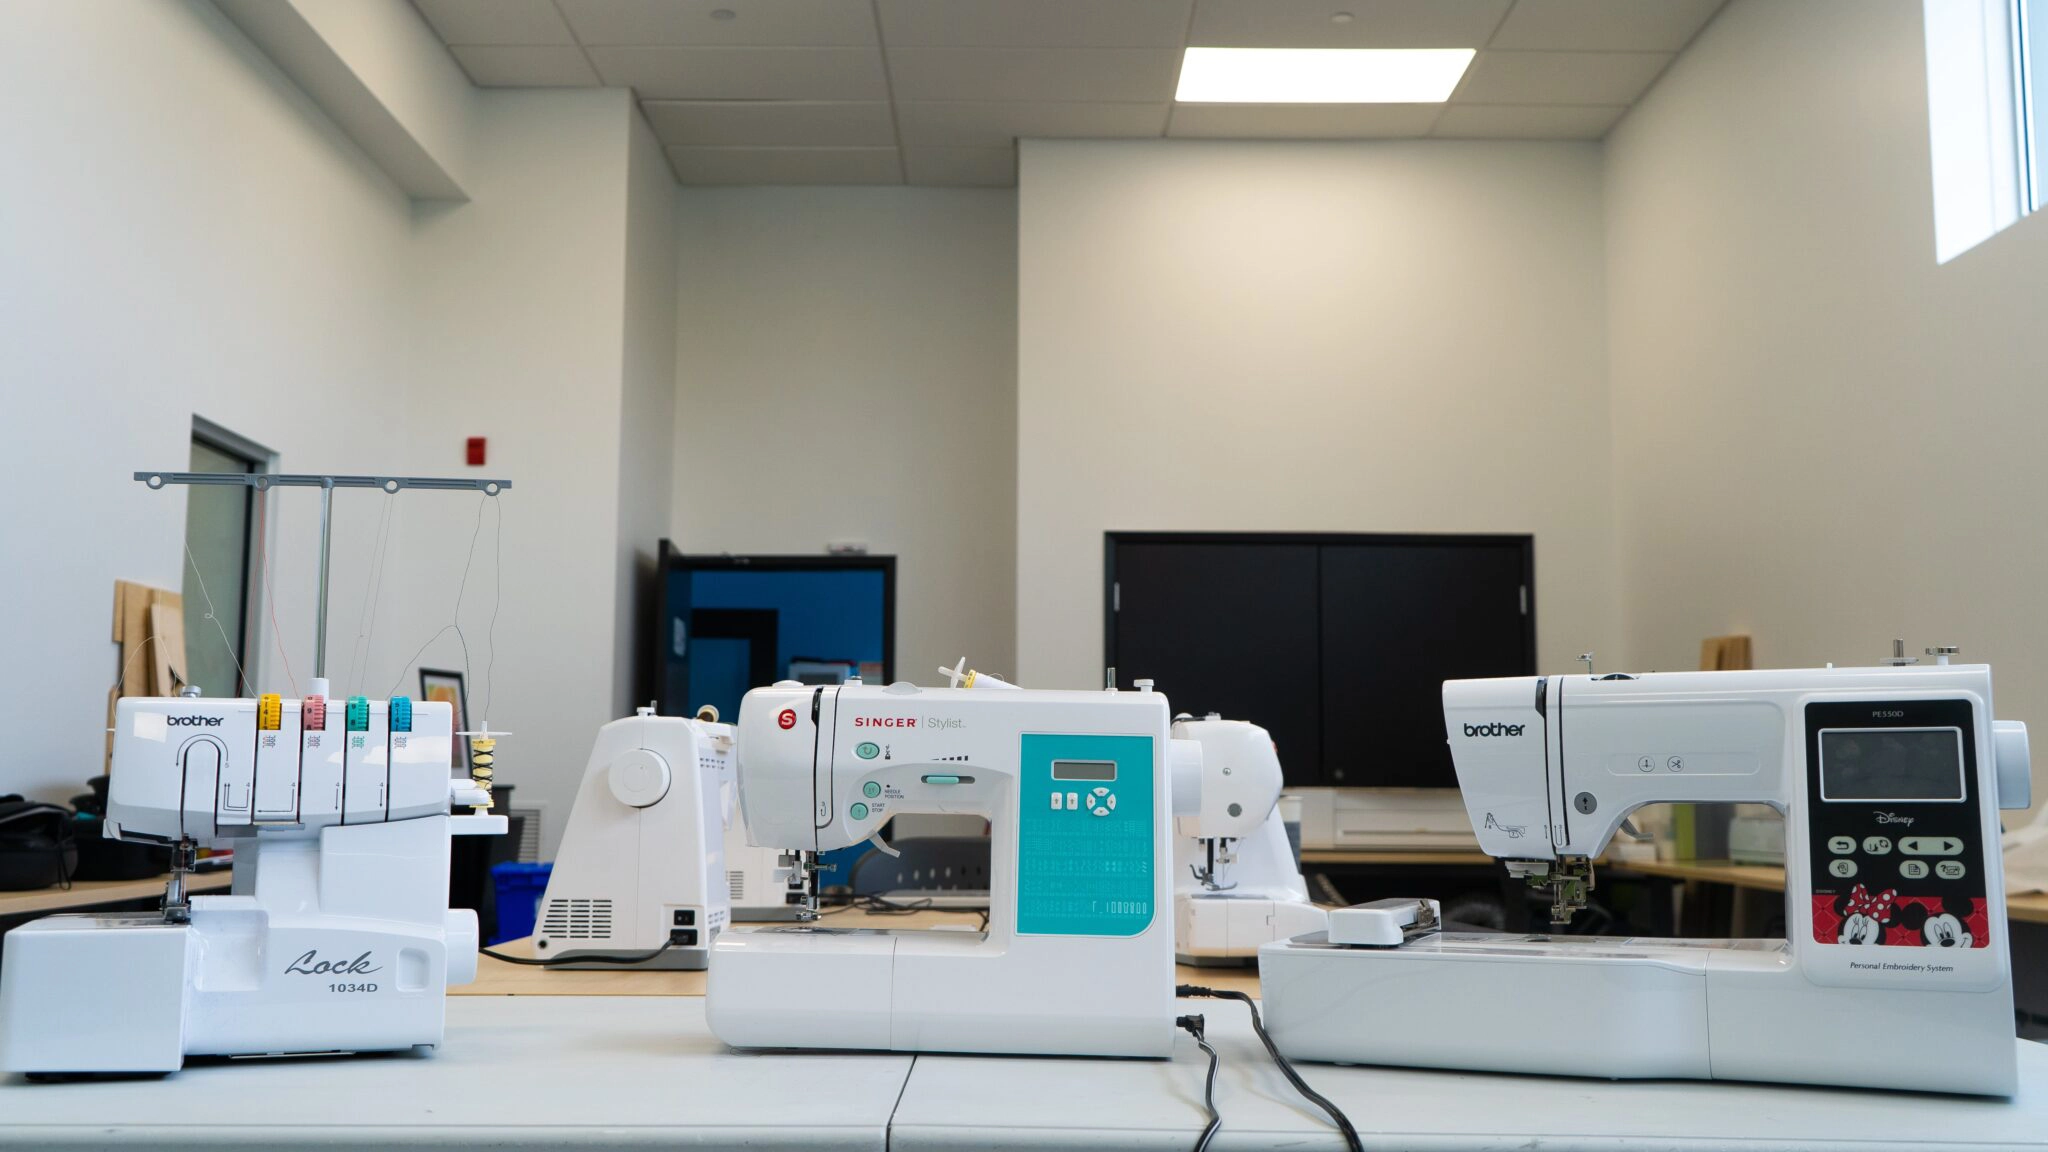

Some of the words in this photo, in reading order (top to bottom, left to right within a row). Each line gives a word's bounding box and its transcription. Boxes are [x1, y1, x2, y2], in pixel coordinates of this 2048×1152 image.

[167, 714, 224, 728] brother
[855, 717, 916, 728] SINGER
[1464, 722, 1526, 737] brother
[1873, 811, 1915, 827] Disney
[284, 949, 383, 975] Lock
[1849, 961, 1881, 970] Personal
[1882, 963, 1925, 973] Embroidery
[1926, 964, 1954, 973] System
[328, 983, 378, 993] 1034D
